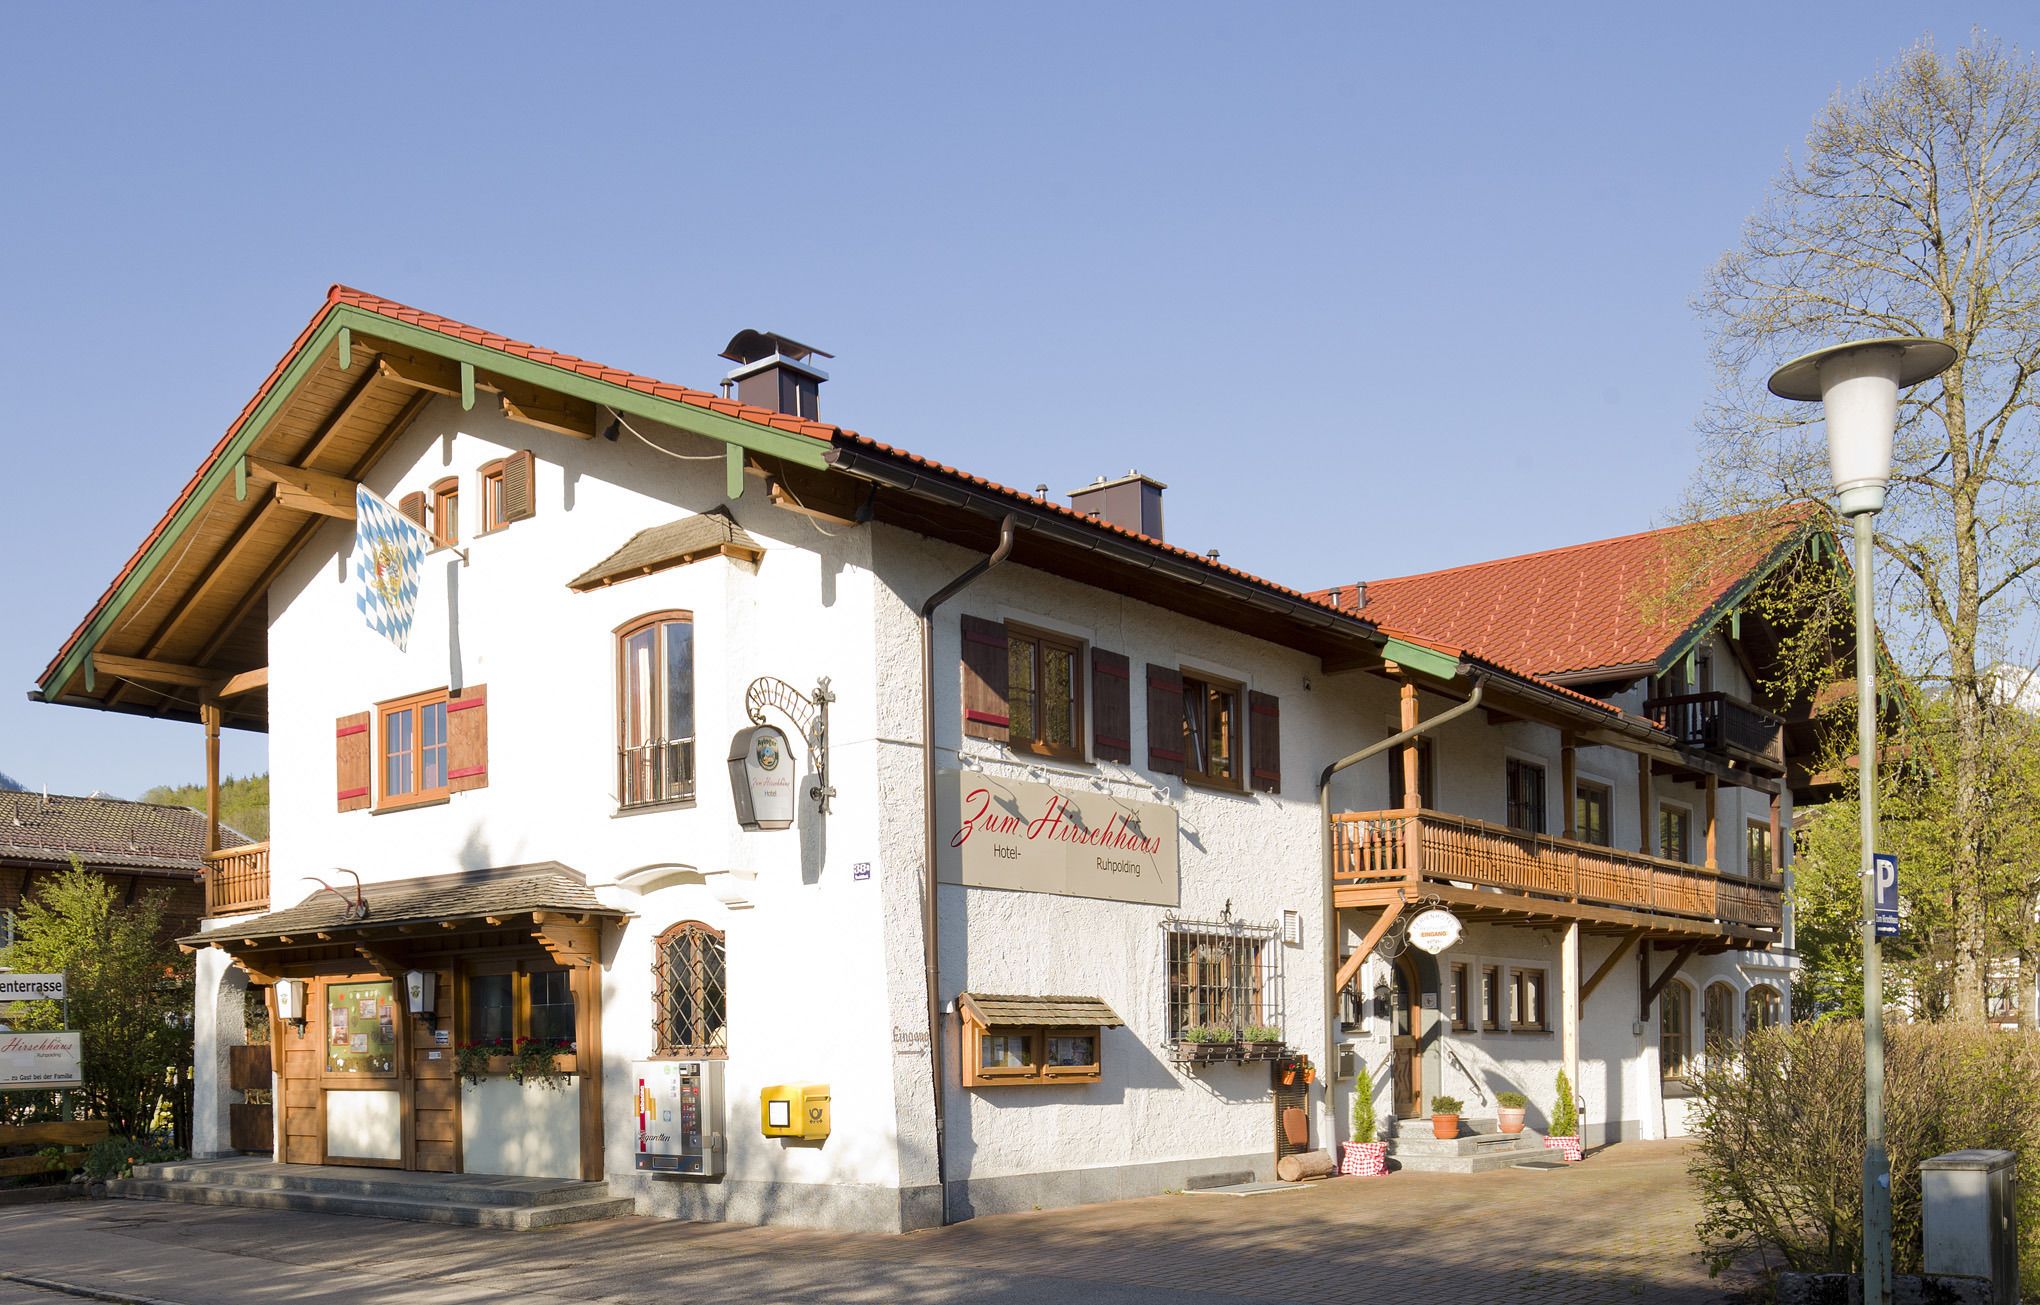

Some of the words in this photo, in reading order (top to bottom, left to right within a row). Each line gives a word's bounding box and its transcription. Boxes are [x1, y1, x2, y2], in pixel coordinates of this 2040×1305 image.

[950, 788, 1020, 848] Zum
[1026, 795, 1161, 855] Hirschhaus
[993, 843, 1021, 860] Hotel-
[1096, 857, 1141, 877] Ruhpolding
[1876, 858, 1895, 904] P
[0, 980, 62, 992] enterrasse
[1, 1037, 73, 1052] Hirschhaus
[893, 1025, 929, 1048] Eingang
